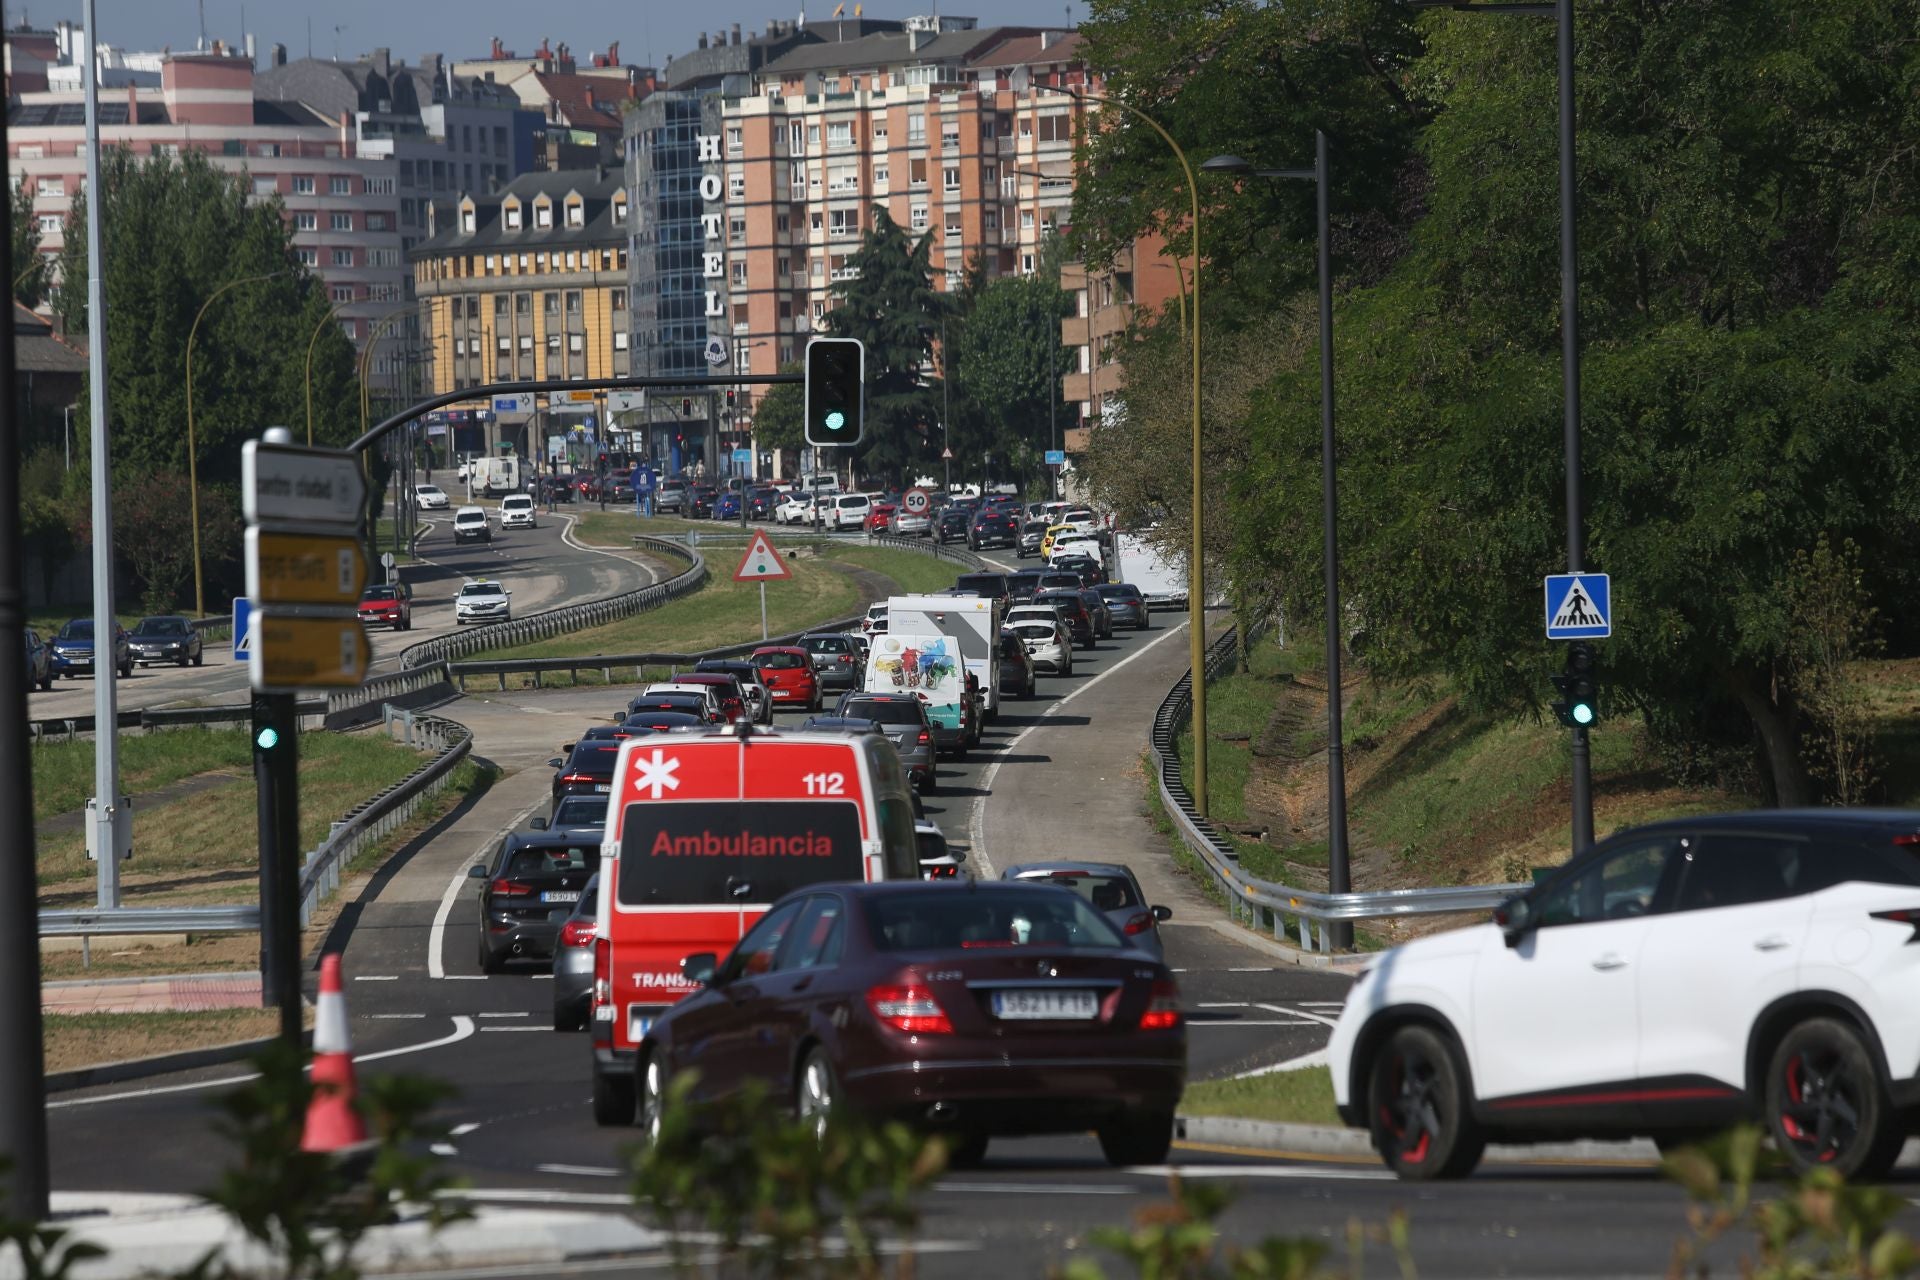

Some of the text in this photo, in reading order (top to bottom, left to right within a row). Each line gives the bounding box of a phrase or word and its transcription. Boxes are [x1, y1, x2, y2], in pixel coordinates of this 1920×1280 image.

[697, 134, 724, 317] HOTEL
[908, 496, 925, 506] 50
[802, 772, 845, 795] 112
[651, 830, 833, 857] Ambulancia
